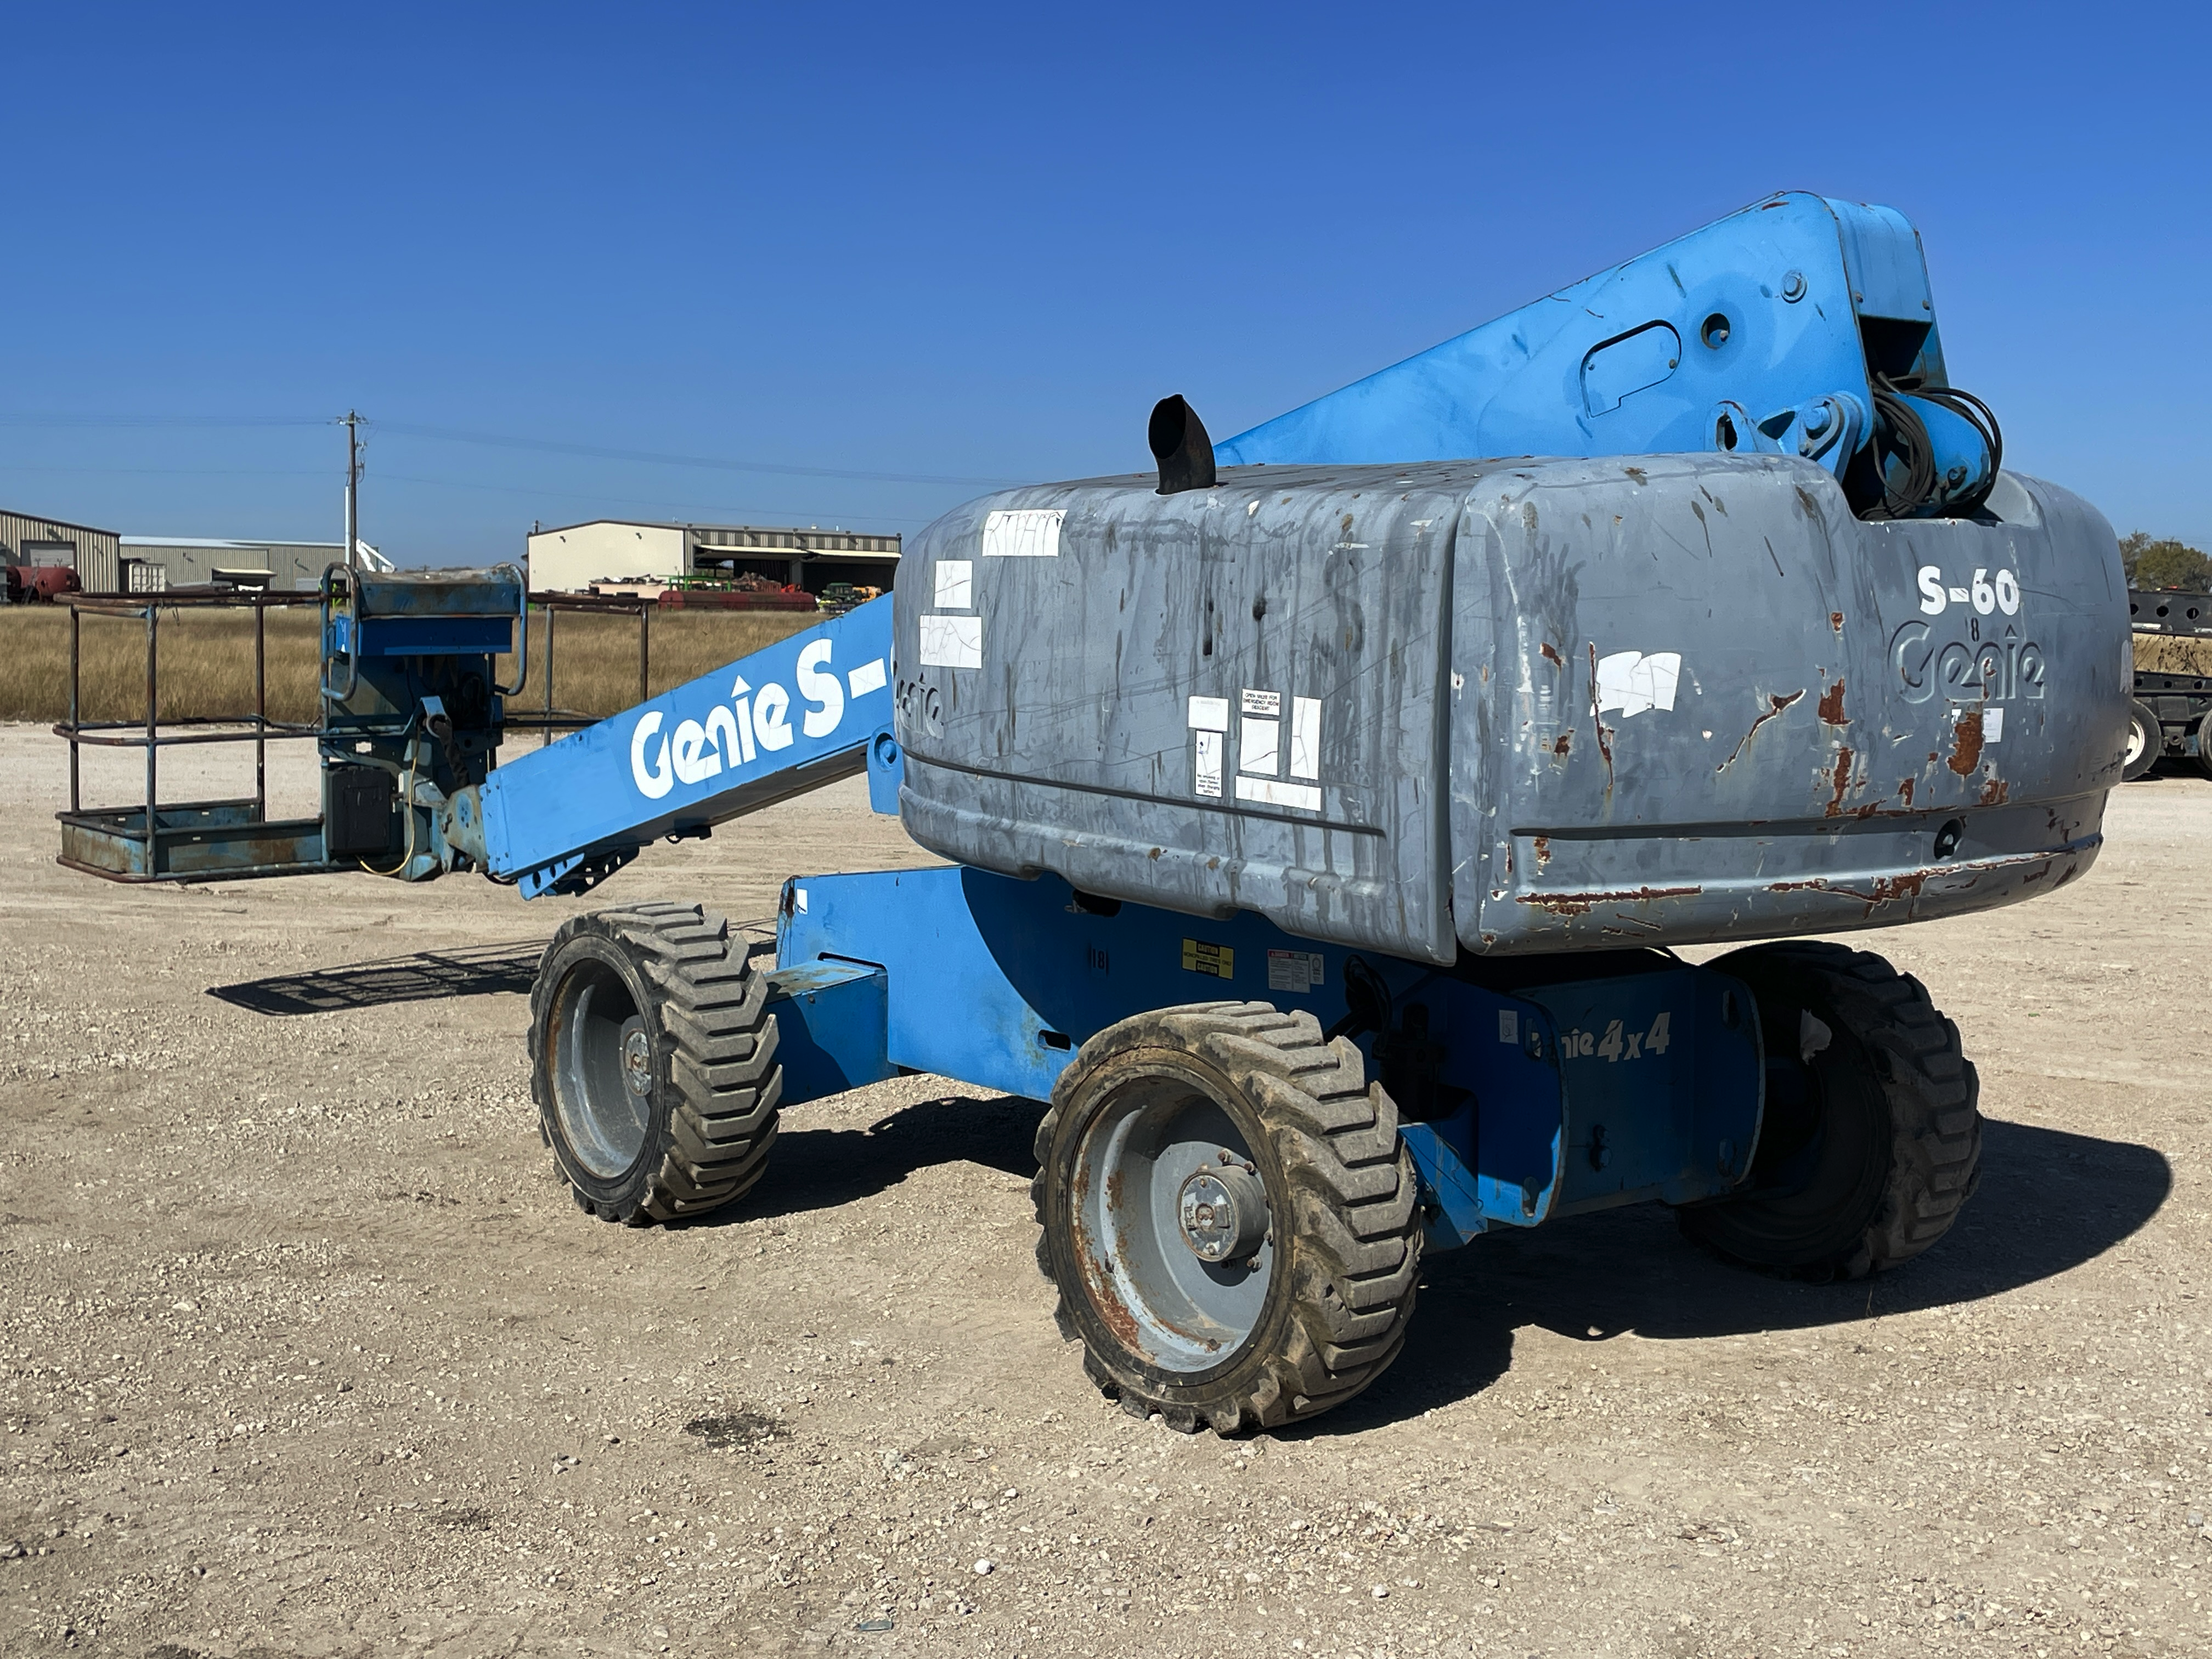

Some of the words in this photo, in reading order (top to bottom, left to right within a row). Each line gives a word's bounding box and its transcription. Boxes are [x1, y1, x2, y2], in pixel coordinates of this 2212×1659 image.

[1918, 566, 2019, 616] S-60
[1888, 620, 2044, 704] Genie
[631, 675, 793, 799] Genie
[797, 639, 894, 738] S-
[1598, 1012, 1671, 1063] 4x4
